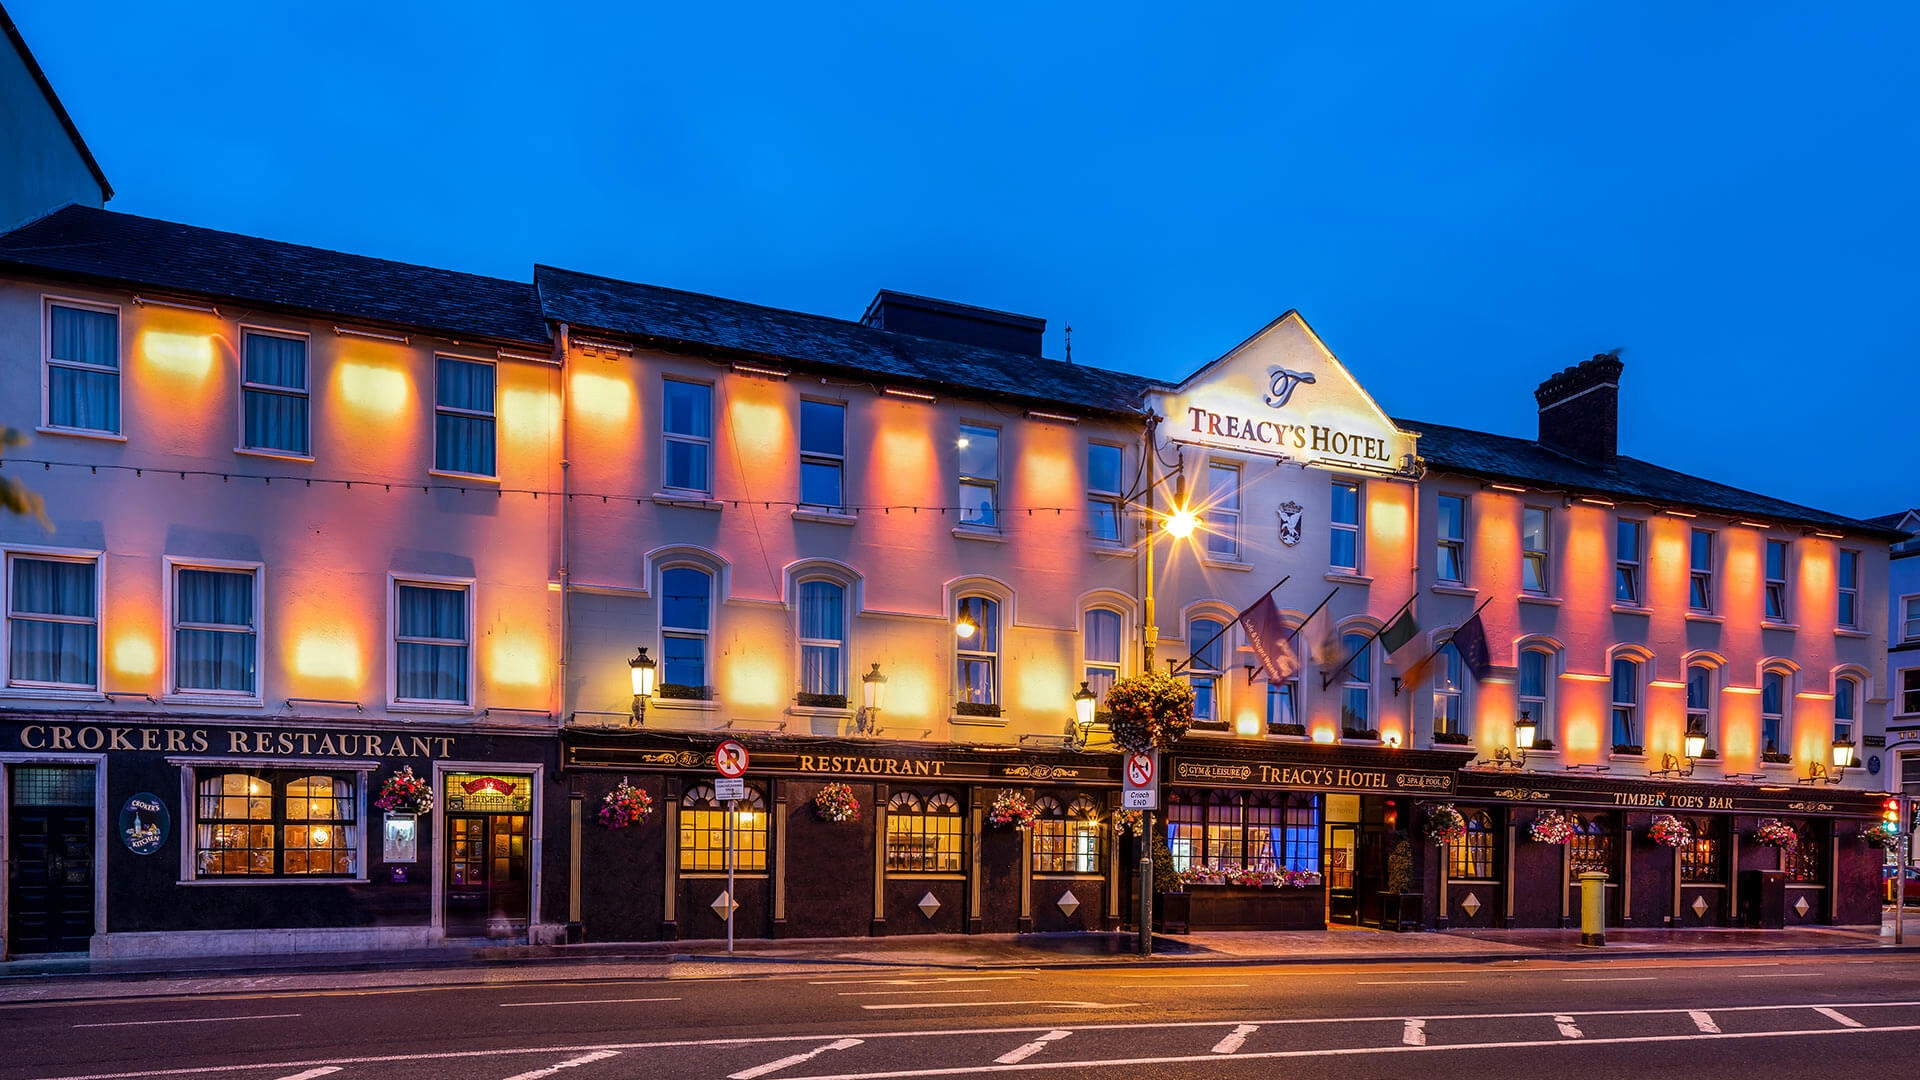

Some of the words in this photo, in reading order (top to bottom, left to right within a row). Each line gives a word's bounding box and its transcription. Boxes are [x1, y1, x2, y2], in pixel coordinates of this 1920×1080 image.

[1188, 407, 1306, 449] TREACY'S
[1310, 425, 1390, 462] HOTEL
[20, 725, 208, 753] CROKERS
[227, 730, 455, 758] RESTAURANT
[800, 755, 945, 775] RESTAURANT
[1189, 766, 1204, 774] GYM
[1212, 767, 1240, 776] LEISURE
[1259, 765, 1333, 785] TREACY'S
[1337, 769, 1388, 787] HOTEL
[1407, 776, 1418, 784] SPA
[1425, 777, 1441, 785] POOL
[472, 795, 505, 803] KITCHEN
[1614, 792, 1664, 806] TIMBER
[1670, 795, 1703, 808] TOE'S
[1708, 797, 1733, 809] BAR
[132, 835, 160, 848] KITCHEN
